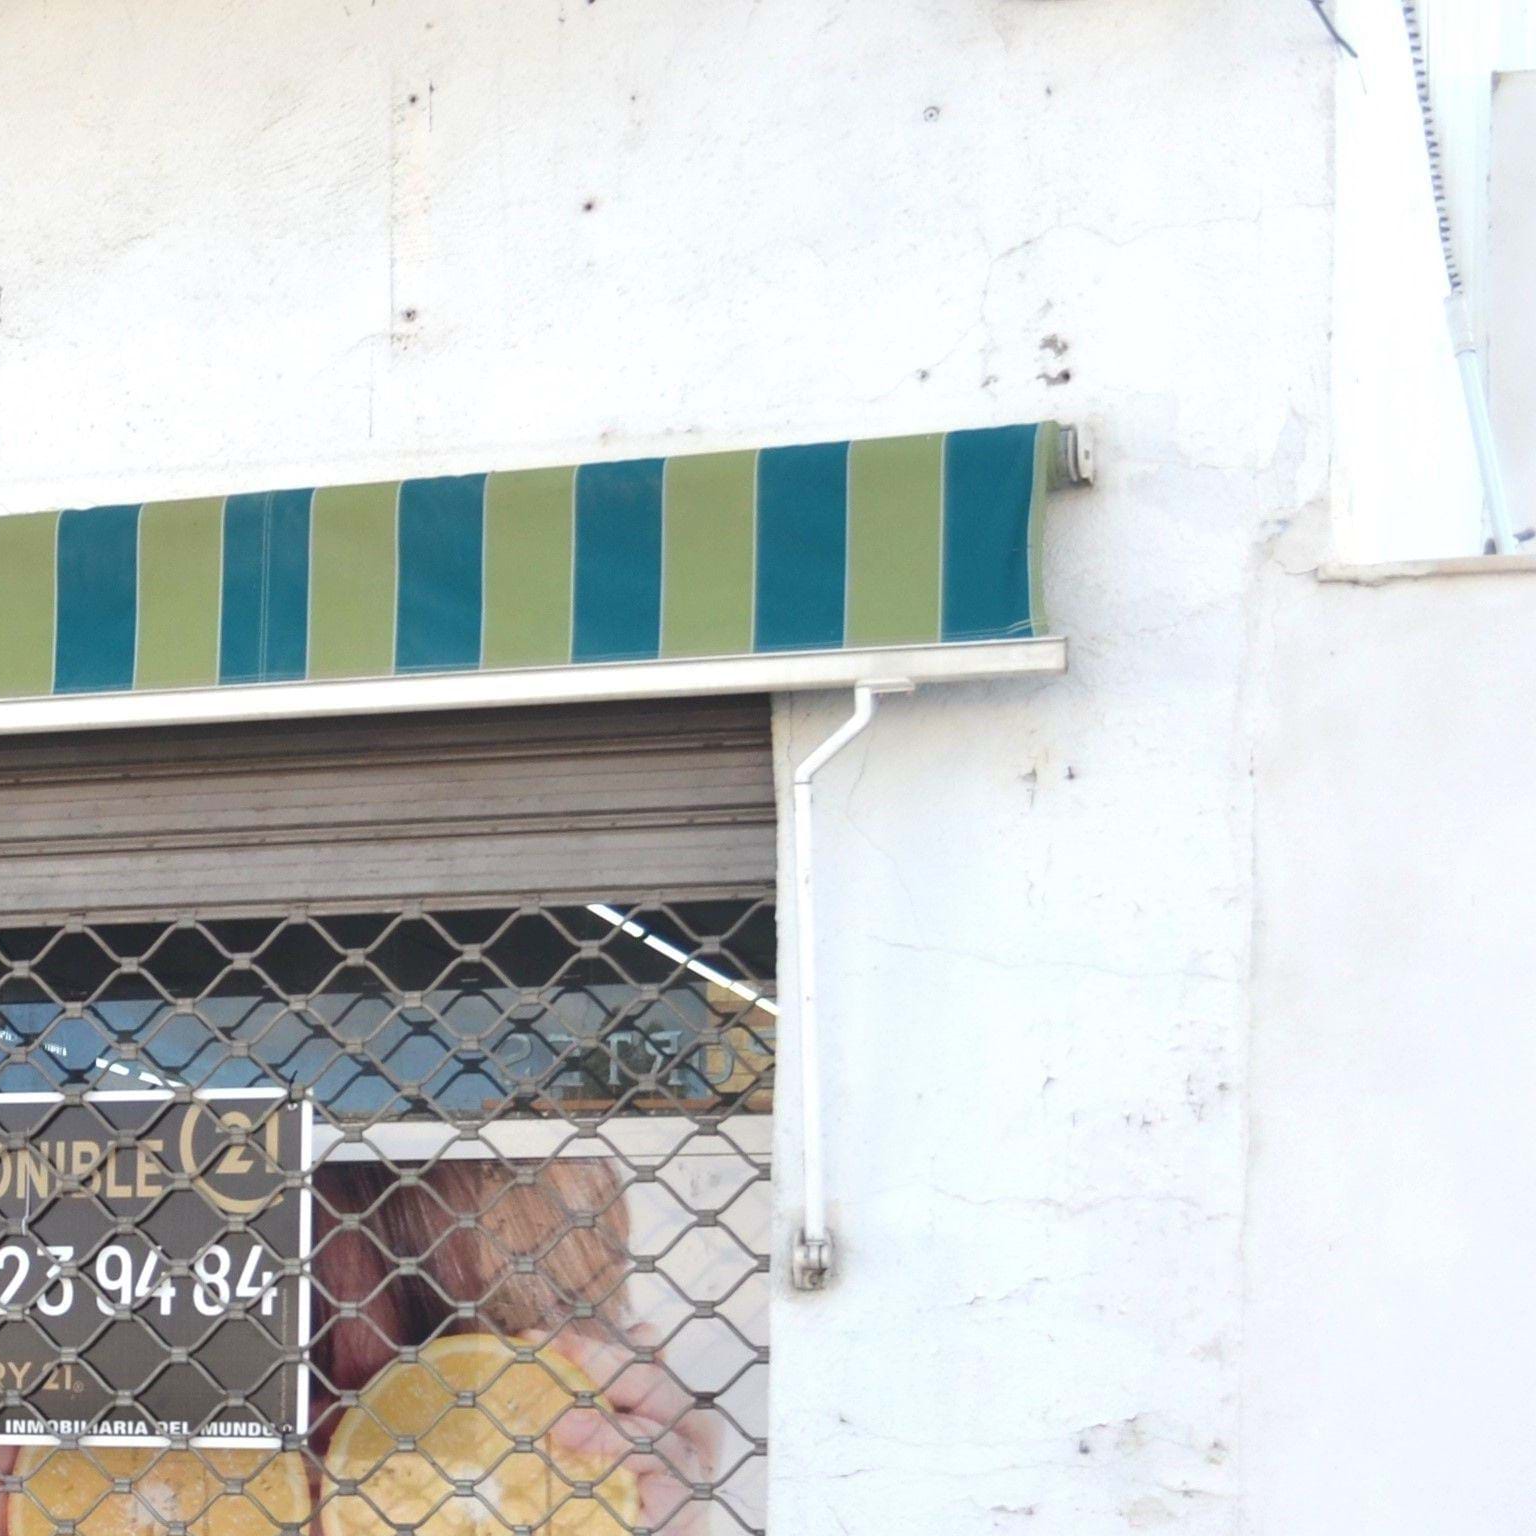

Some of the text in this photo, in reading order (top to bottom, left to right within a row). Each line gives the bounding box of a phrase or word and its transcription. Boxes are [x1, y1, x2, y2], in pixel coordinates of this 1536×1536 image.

[95, 1244, 176, 1316] 94
[192, 1244, 278, 1317] 84
[5, 1419, 149, 1435] INMOBILIARIA
[155, 1421, 192, 1436] DEL
